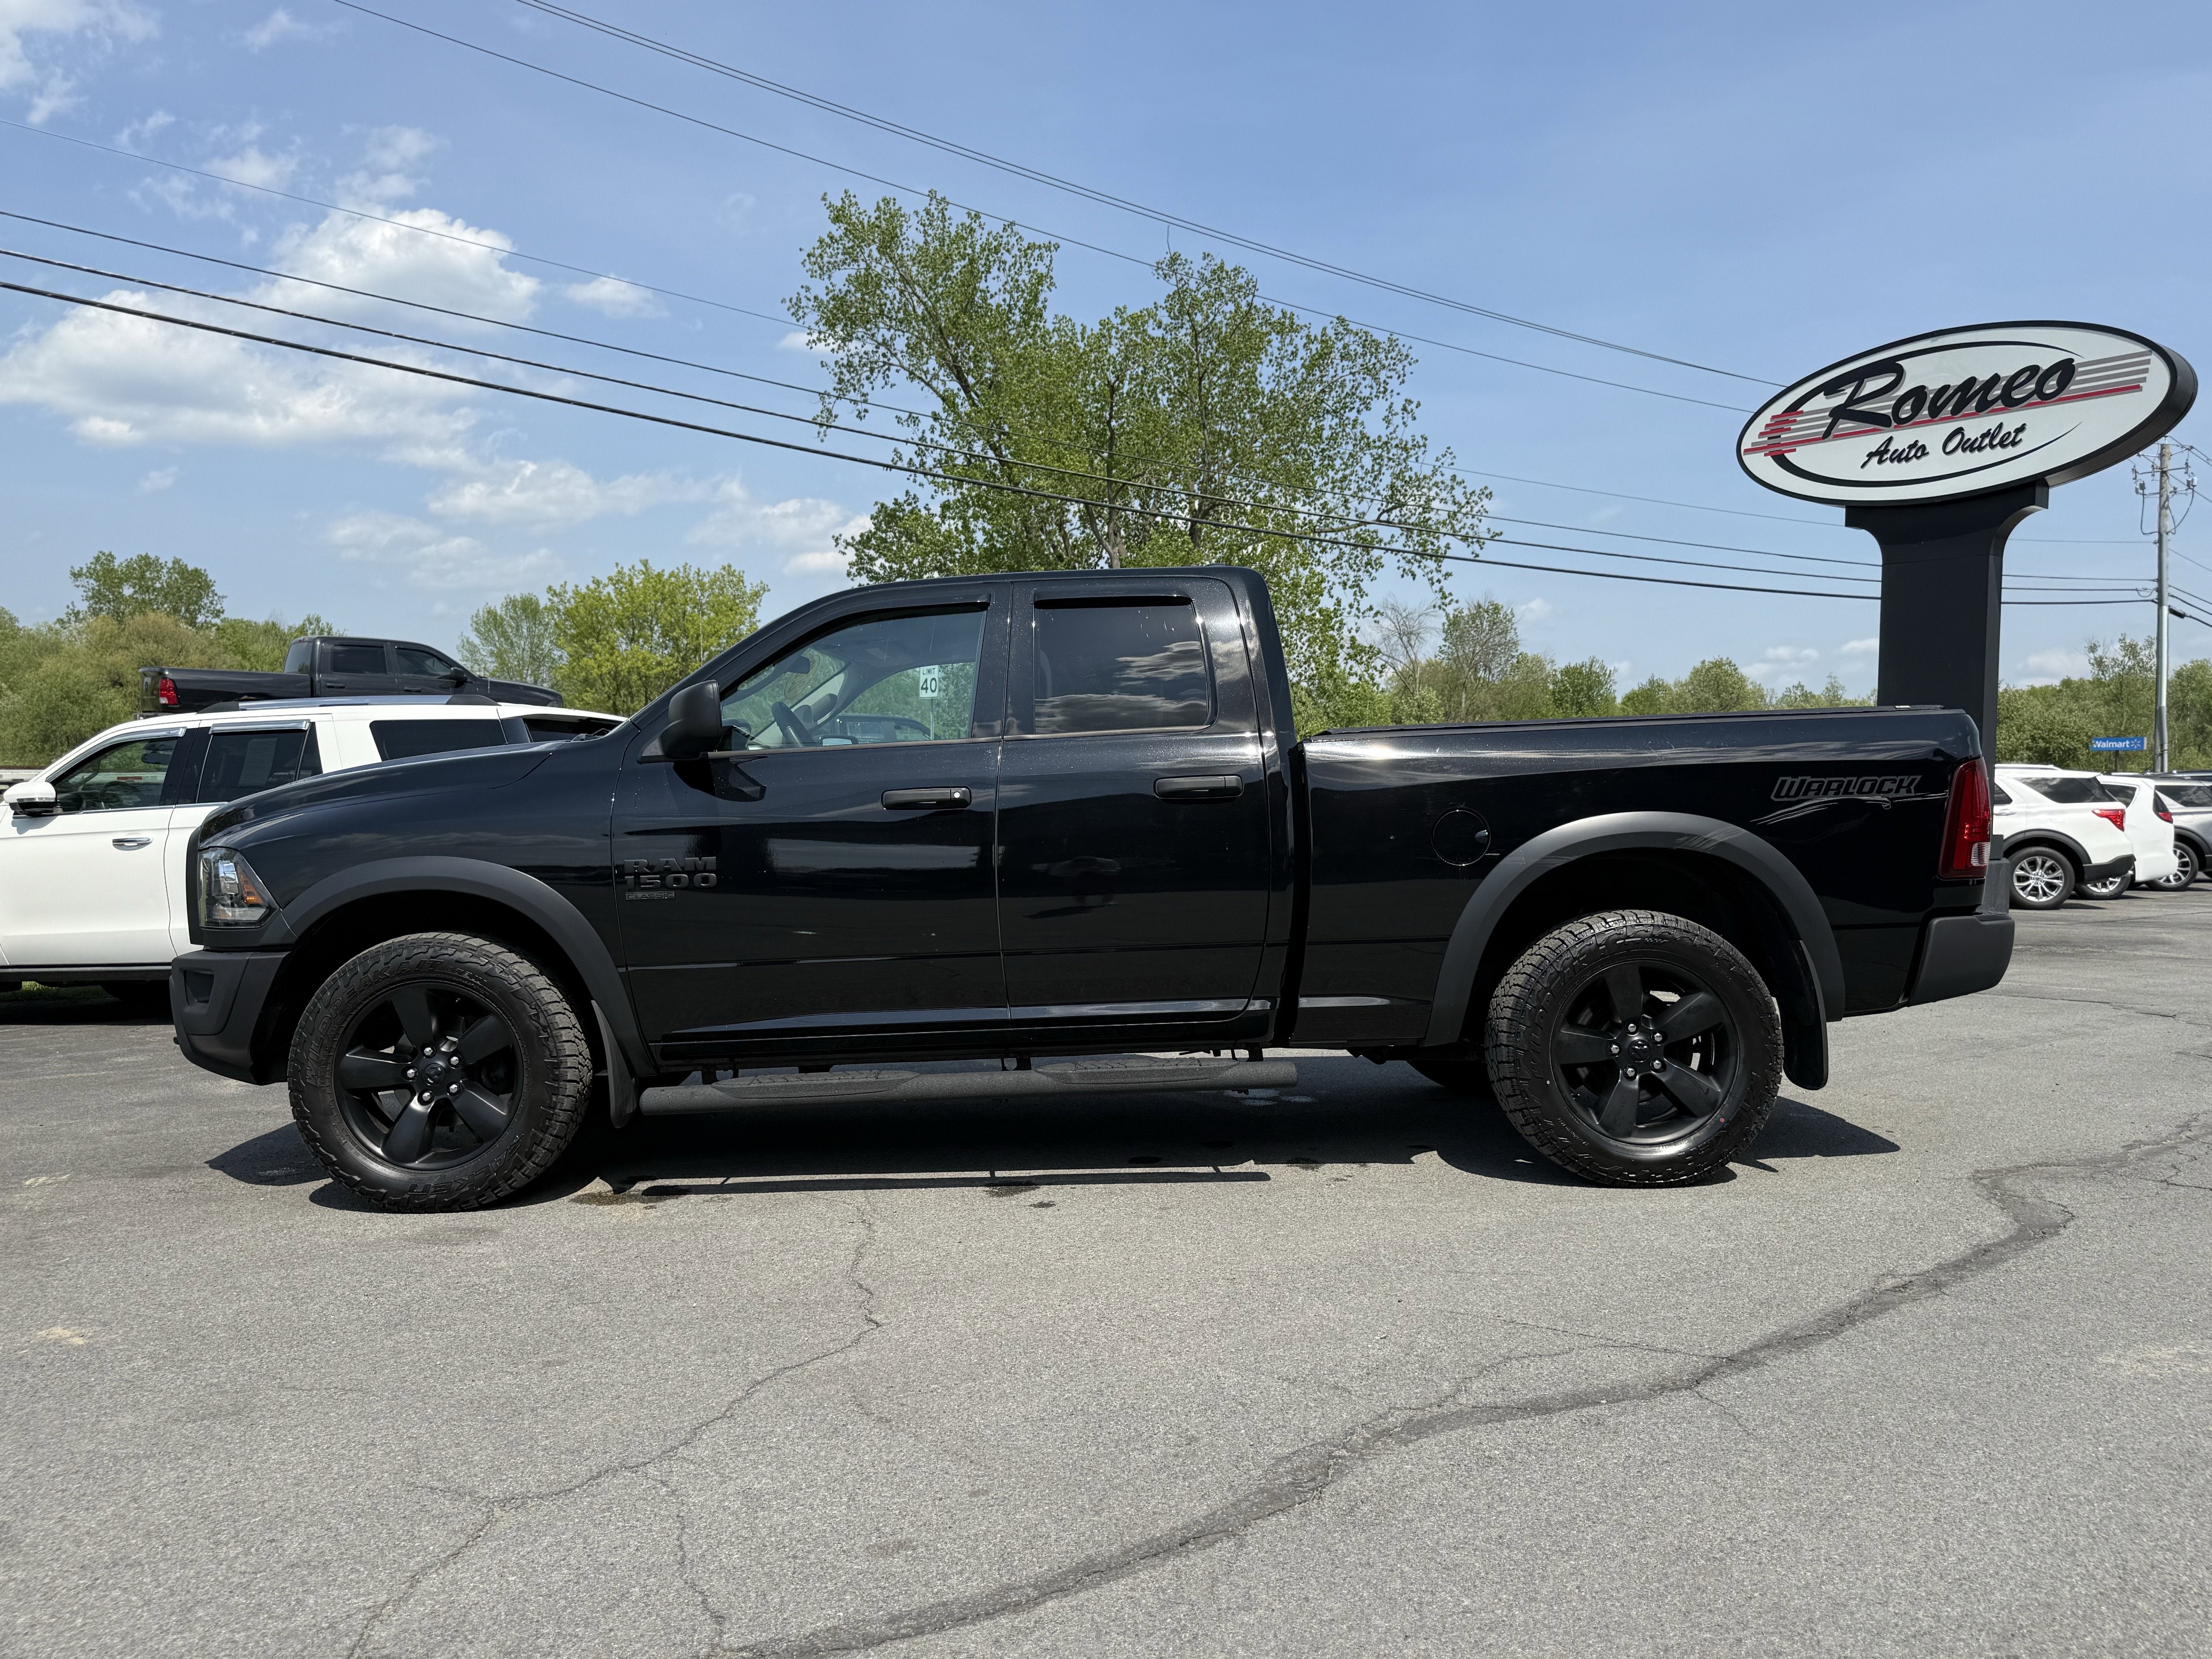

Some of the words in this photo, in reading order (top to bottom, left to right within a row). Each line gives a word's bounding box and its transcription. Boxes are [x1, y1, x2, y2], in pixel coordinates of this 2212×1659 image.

[1822, 357, 2076, 441] Romeo
[1860, 436, 1929, 469] Auto
[1941, 423, 2028, 455] Outlet
[921, 678, 937, 693] 40
[1771, 776, 1921, 801] WARLOCK
[624, 857, 716, 873] RAM
[624, 873, 717, 890] 1500
[306, 965, 390, 1087] WILDPEAK
